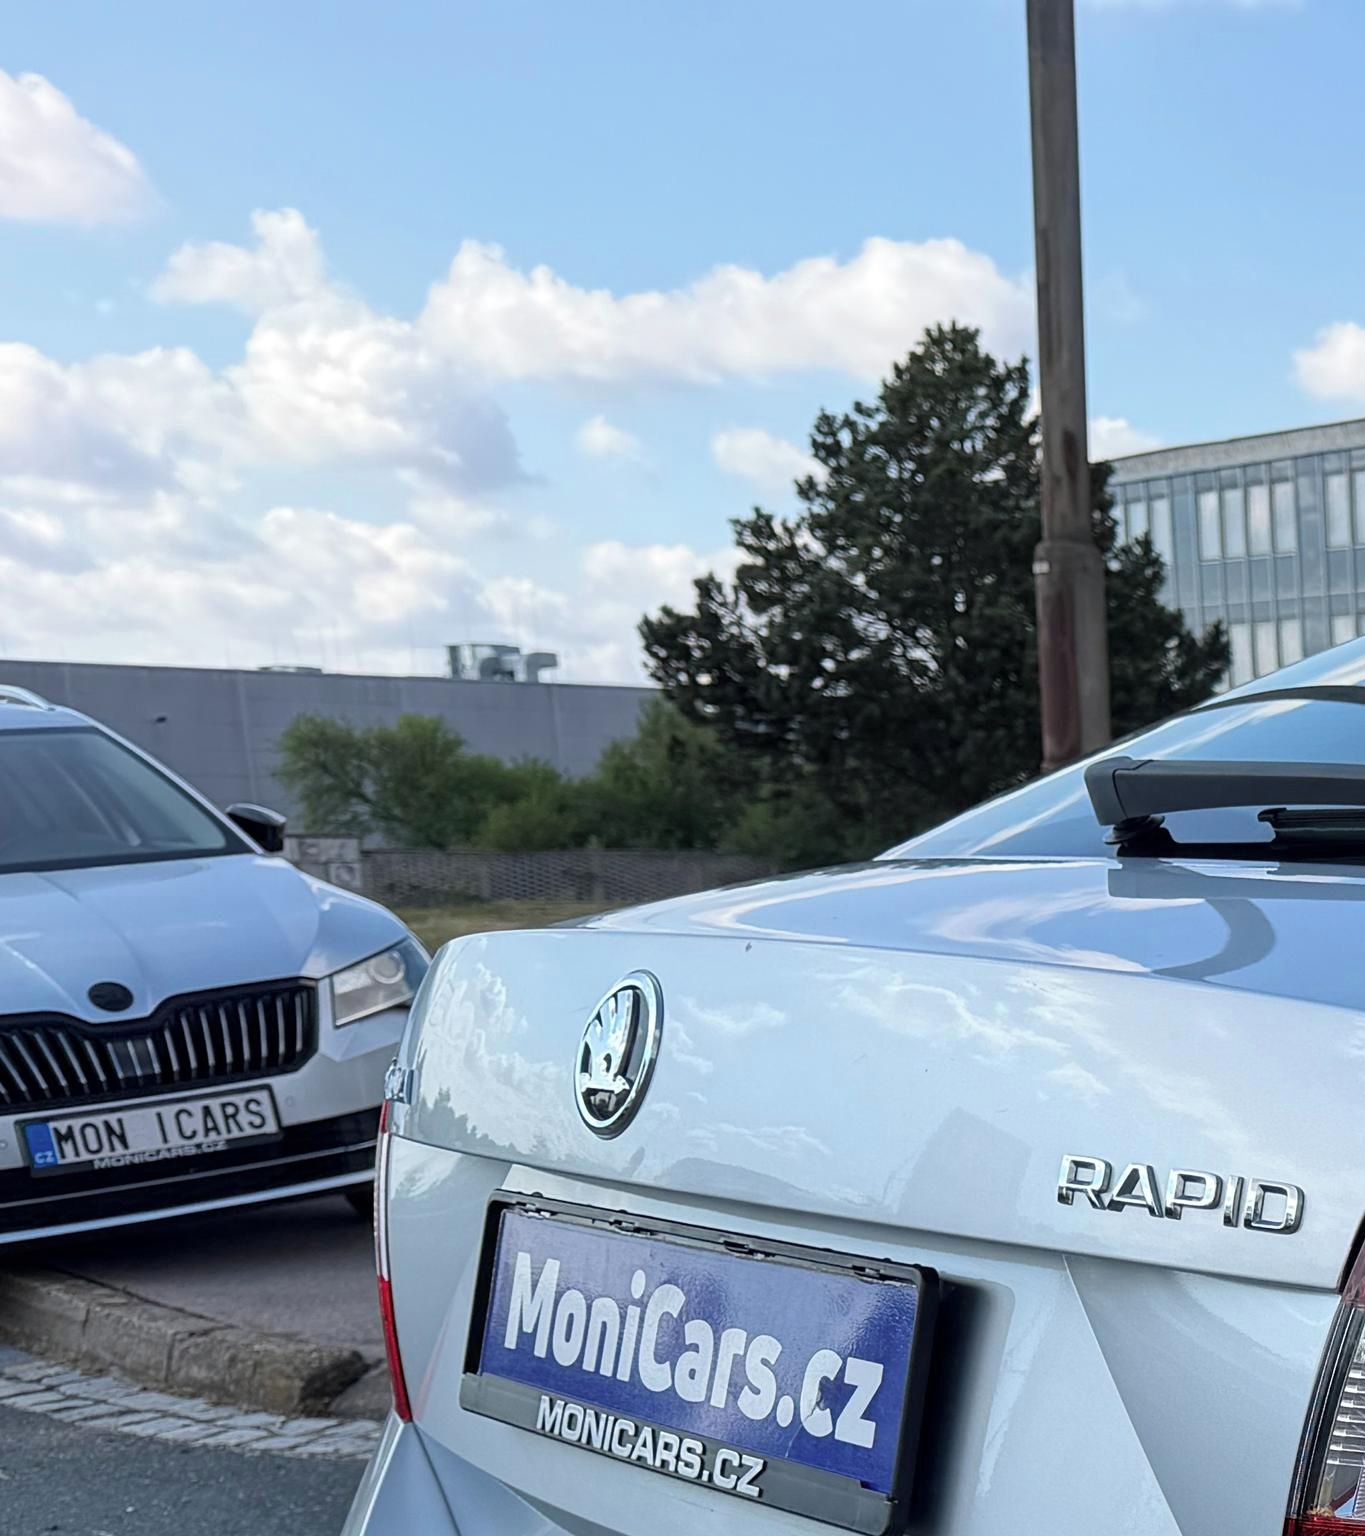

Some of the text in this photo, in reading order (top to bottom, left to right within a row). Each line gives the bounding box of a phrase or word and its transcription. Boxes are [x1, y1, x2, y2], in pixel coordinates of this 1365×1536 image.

[35, 1150, 55, 1165] CZ
[53, 1117, 129, 1160] MON
[94, 1139, 229, 1170] MONICARS.CZ
[1057, 1154, 1305, 1235] RAPID
[503, 1251, 884, 1449] MoniCars.cz
[536, 1394, 766, 1498] MONICARS.CZ
